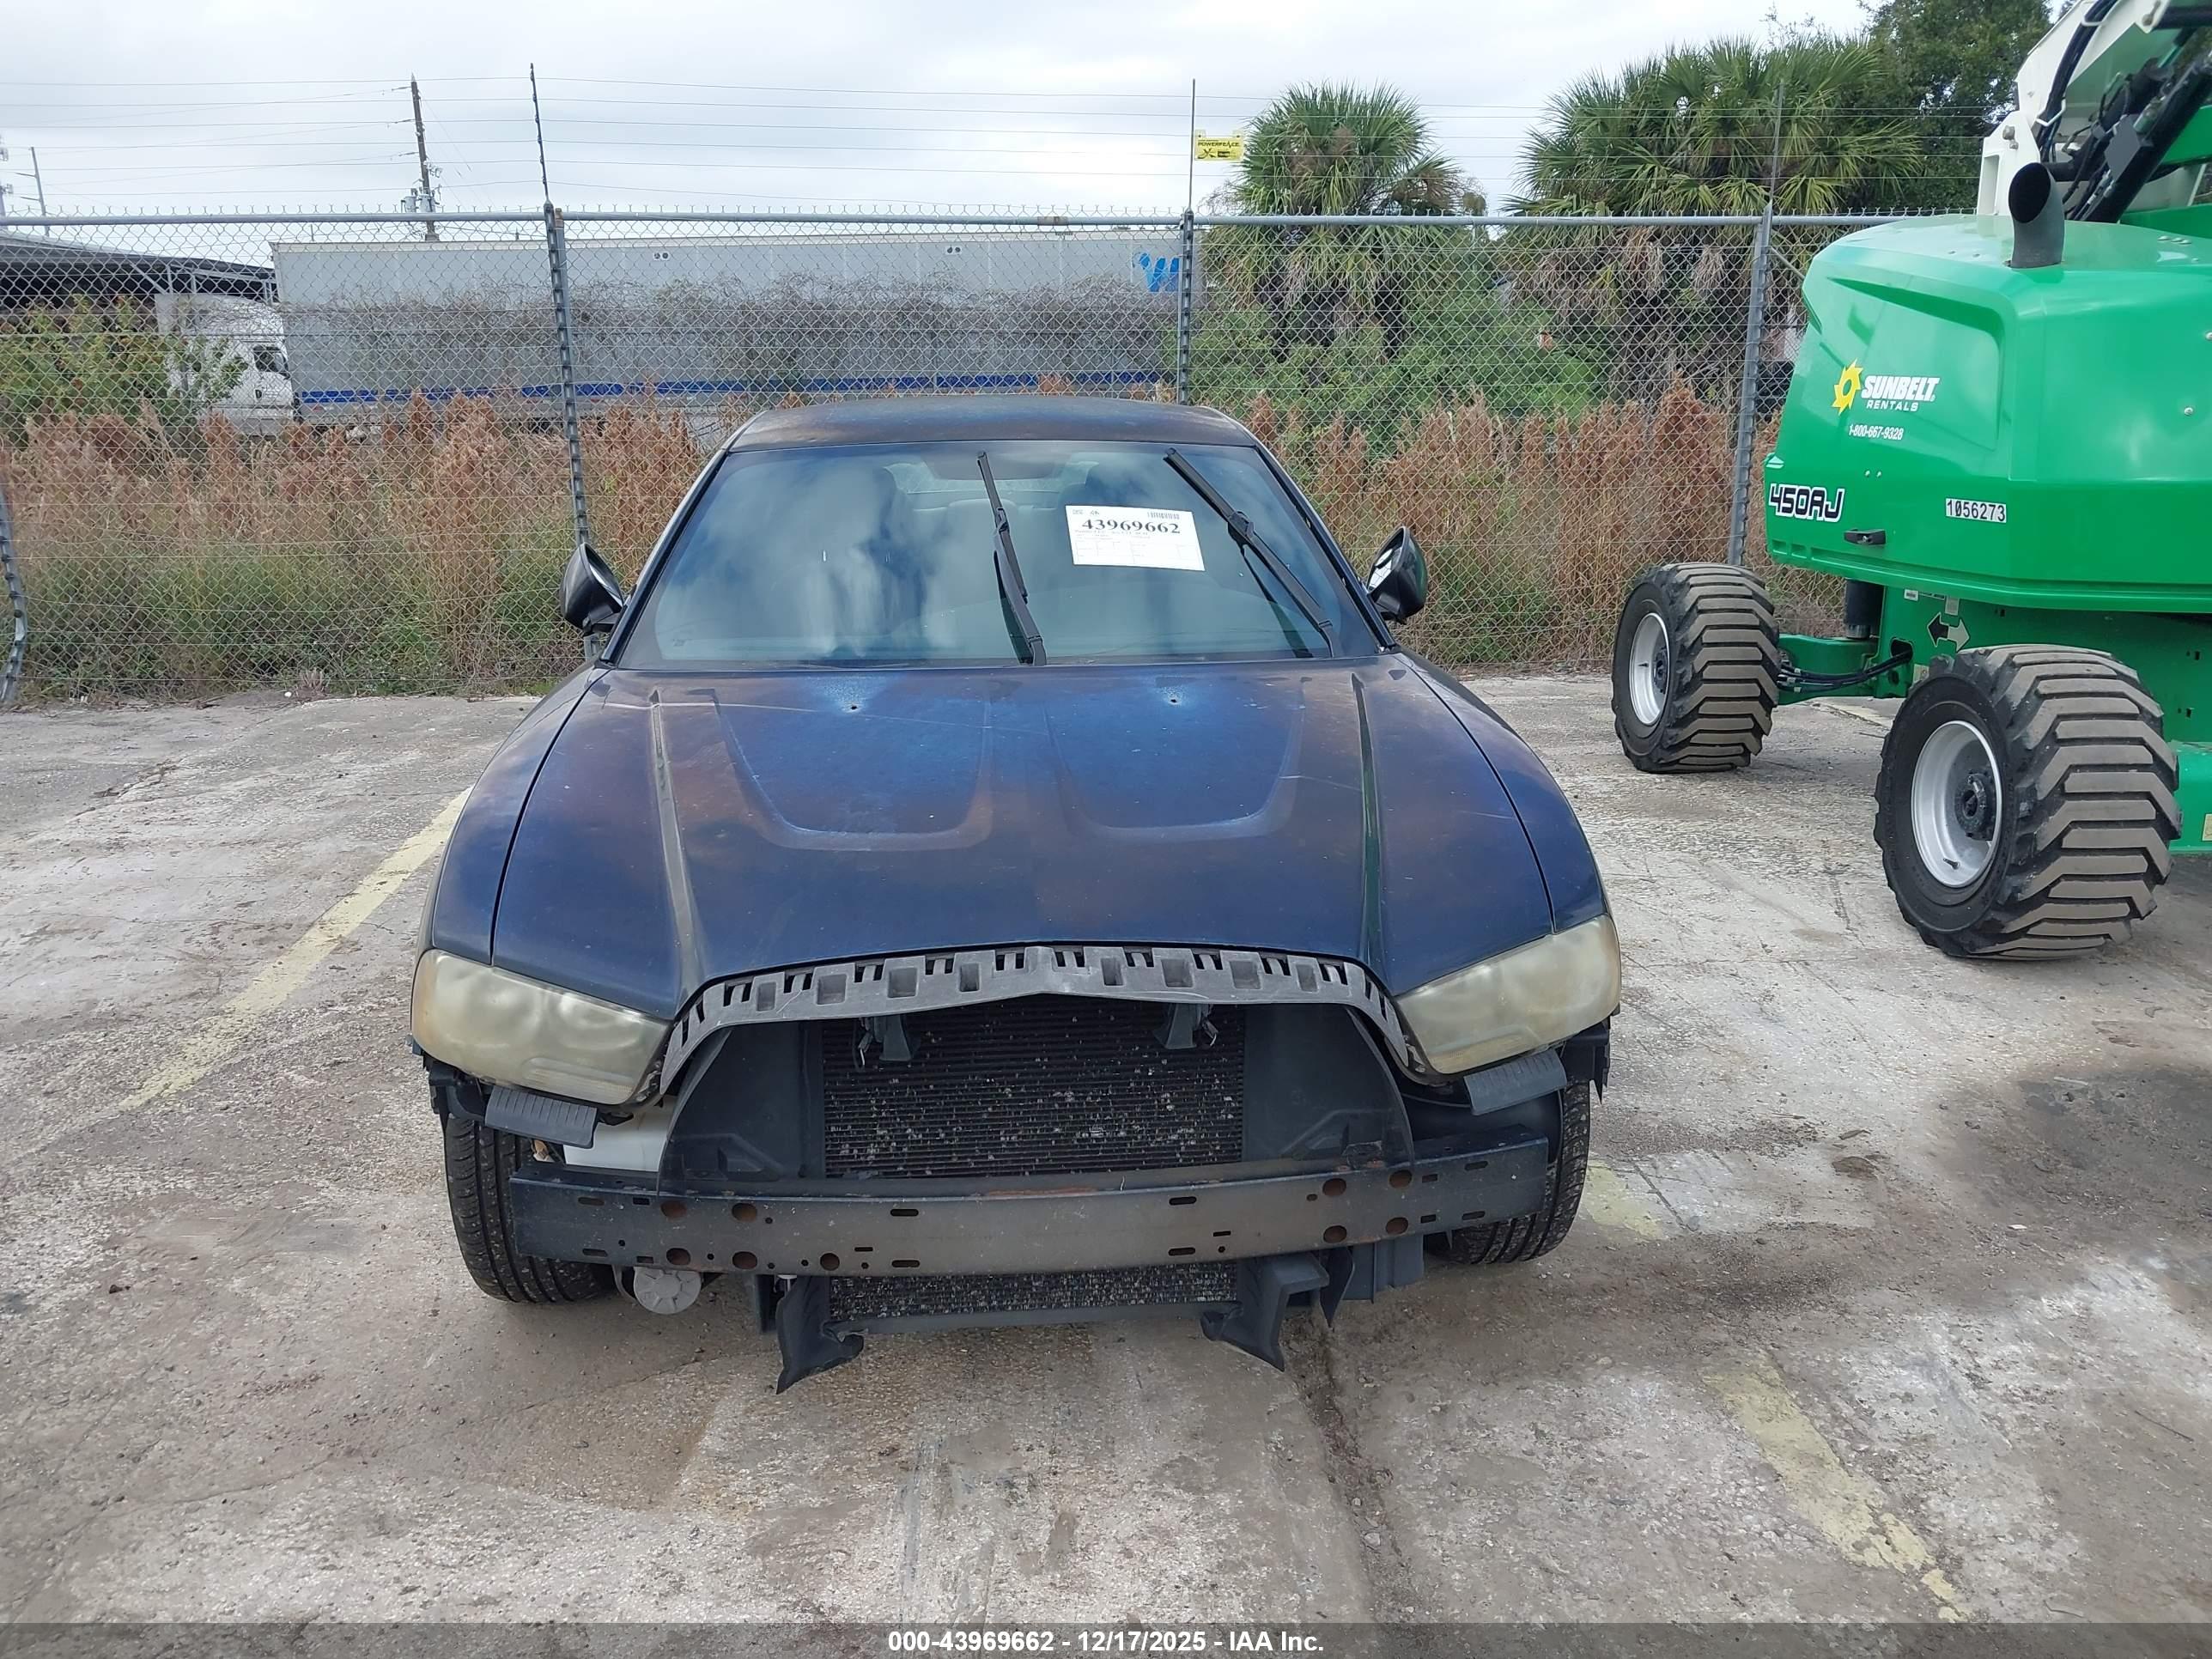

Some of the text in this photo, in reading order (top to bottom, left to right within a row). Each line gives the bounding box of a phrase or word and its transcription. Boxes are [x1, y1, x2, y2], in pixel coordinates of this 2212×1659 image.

[1861, 375, 1940, 402] SUNBELT
[1866, 400, 1919, 412] RENTALS
[1848, 424, 1905, 441] 1-800-667-9328
[1768, 483, 1845, 523] 450AJ
[1946, 499, 2006, 522] 1056273
[1082, 519, 1181, 534] 43969662
